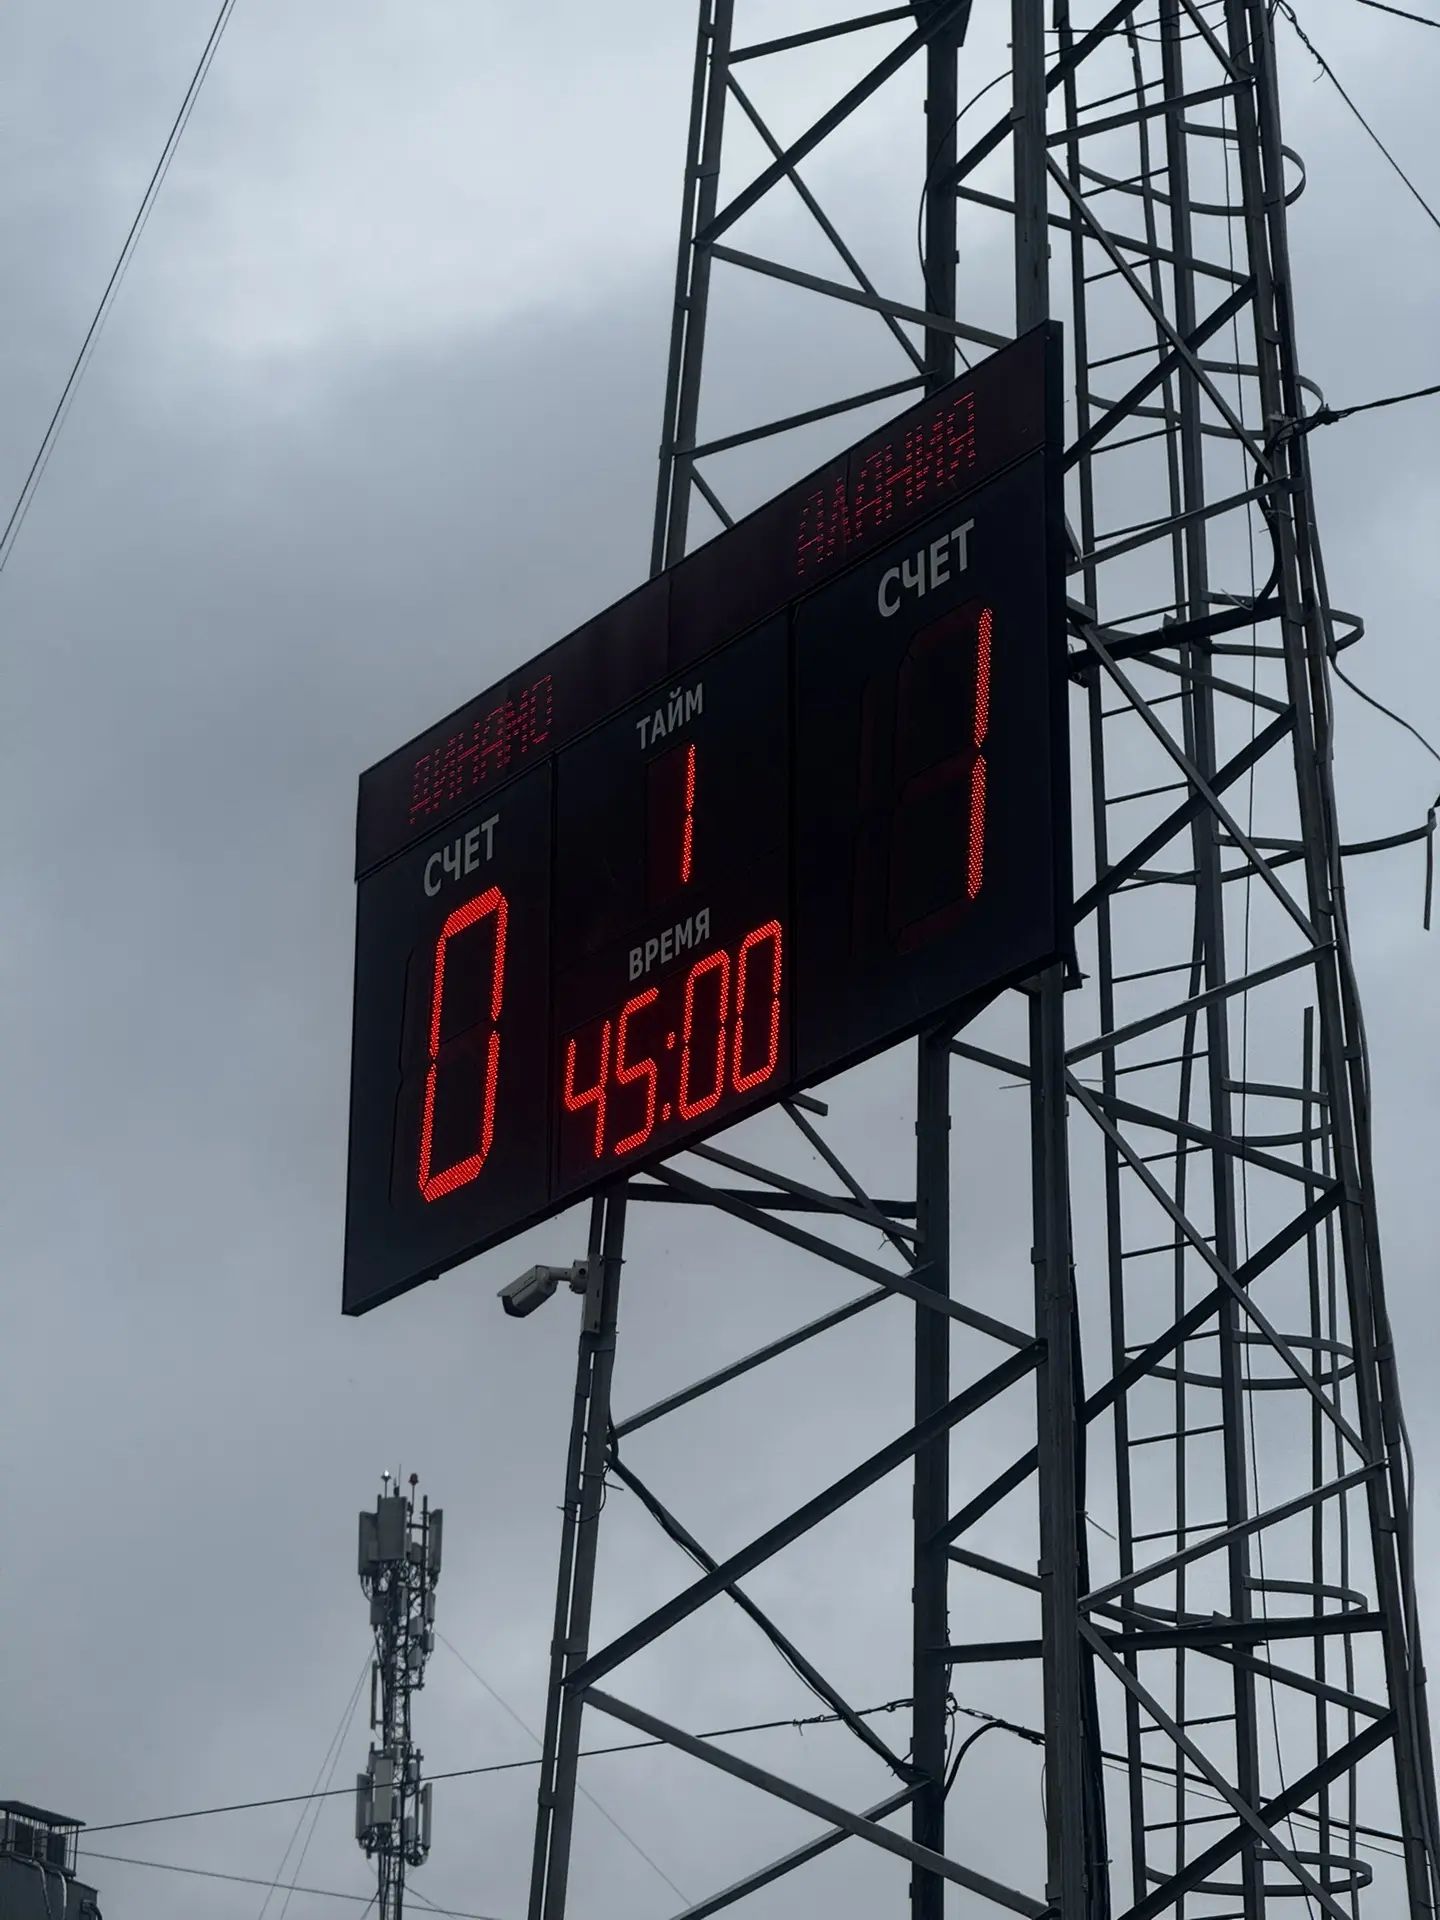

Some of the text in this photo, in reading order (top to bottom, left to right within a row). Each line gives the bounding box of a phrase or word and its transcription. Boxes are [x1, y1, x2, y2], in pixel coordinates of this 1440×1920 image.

[876, 517, 976, 618] СЧЕТ
[409, 674, 552, 825] ДИНАМО
[636, 683, 704, 750] ТАЙМ
[967, 609, 992, 900] 1
[423, 814, 500, 898] СЧЕТ
[679, 744, 696, 884] 1
[628, 908, 711, 981] ВРЕМЯ
[417, 884, 509, 1203] 0
[561, 919, 784, 1160] 45:00
